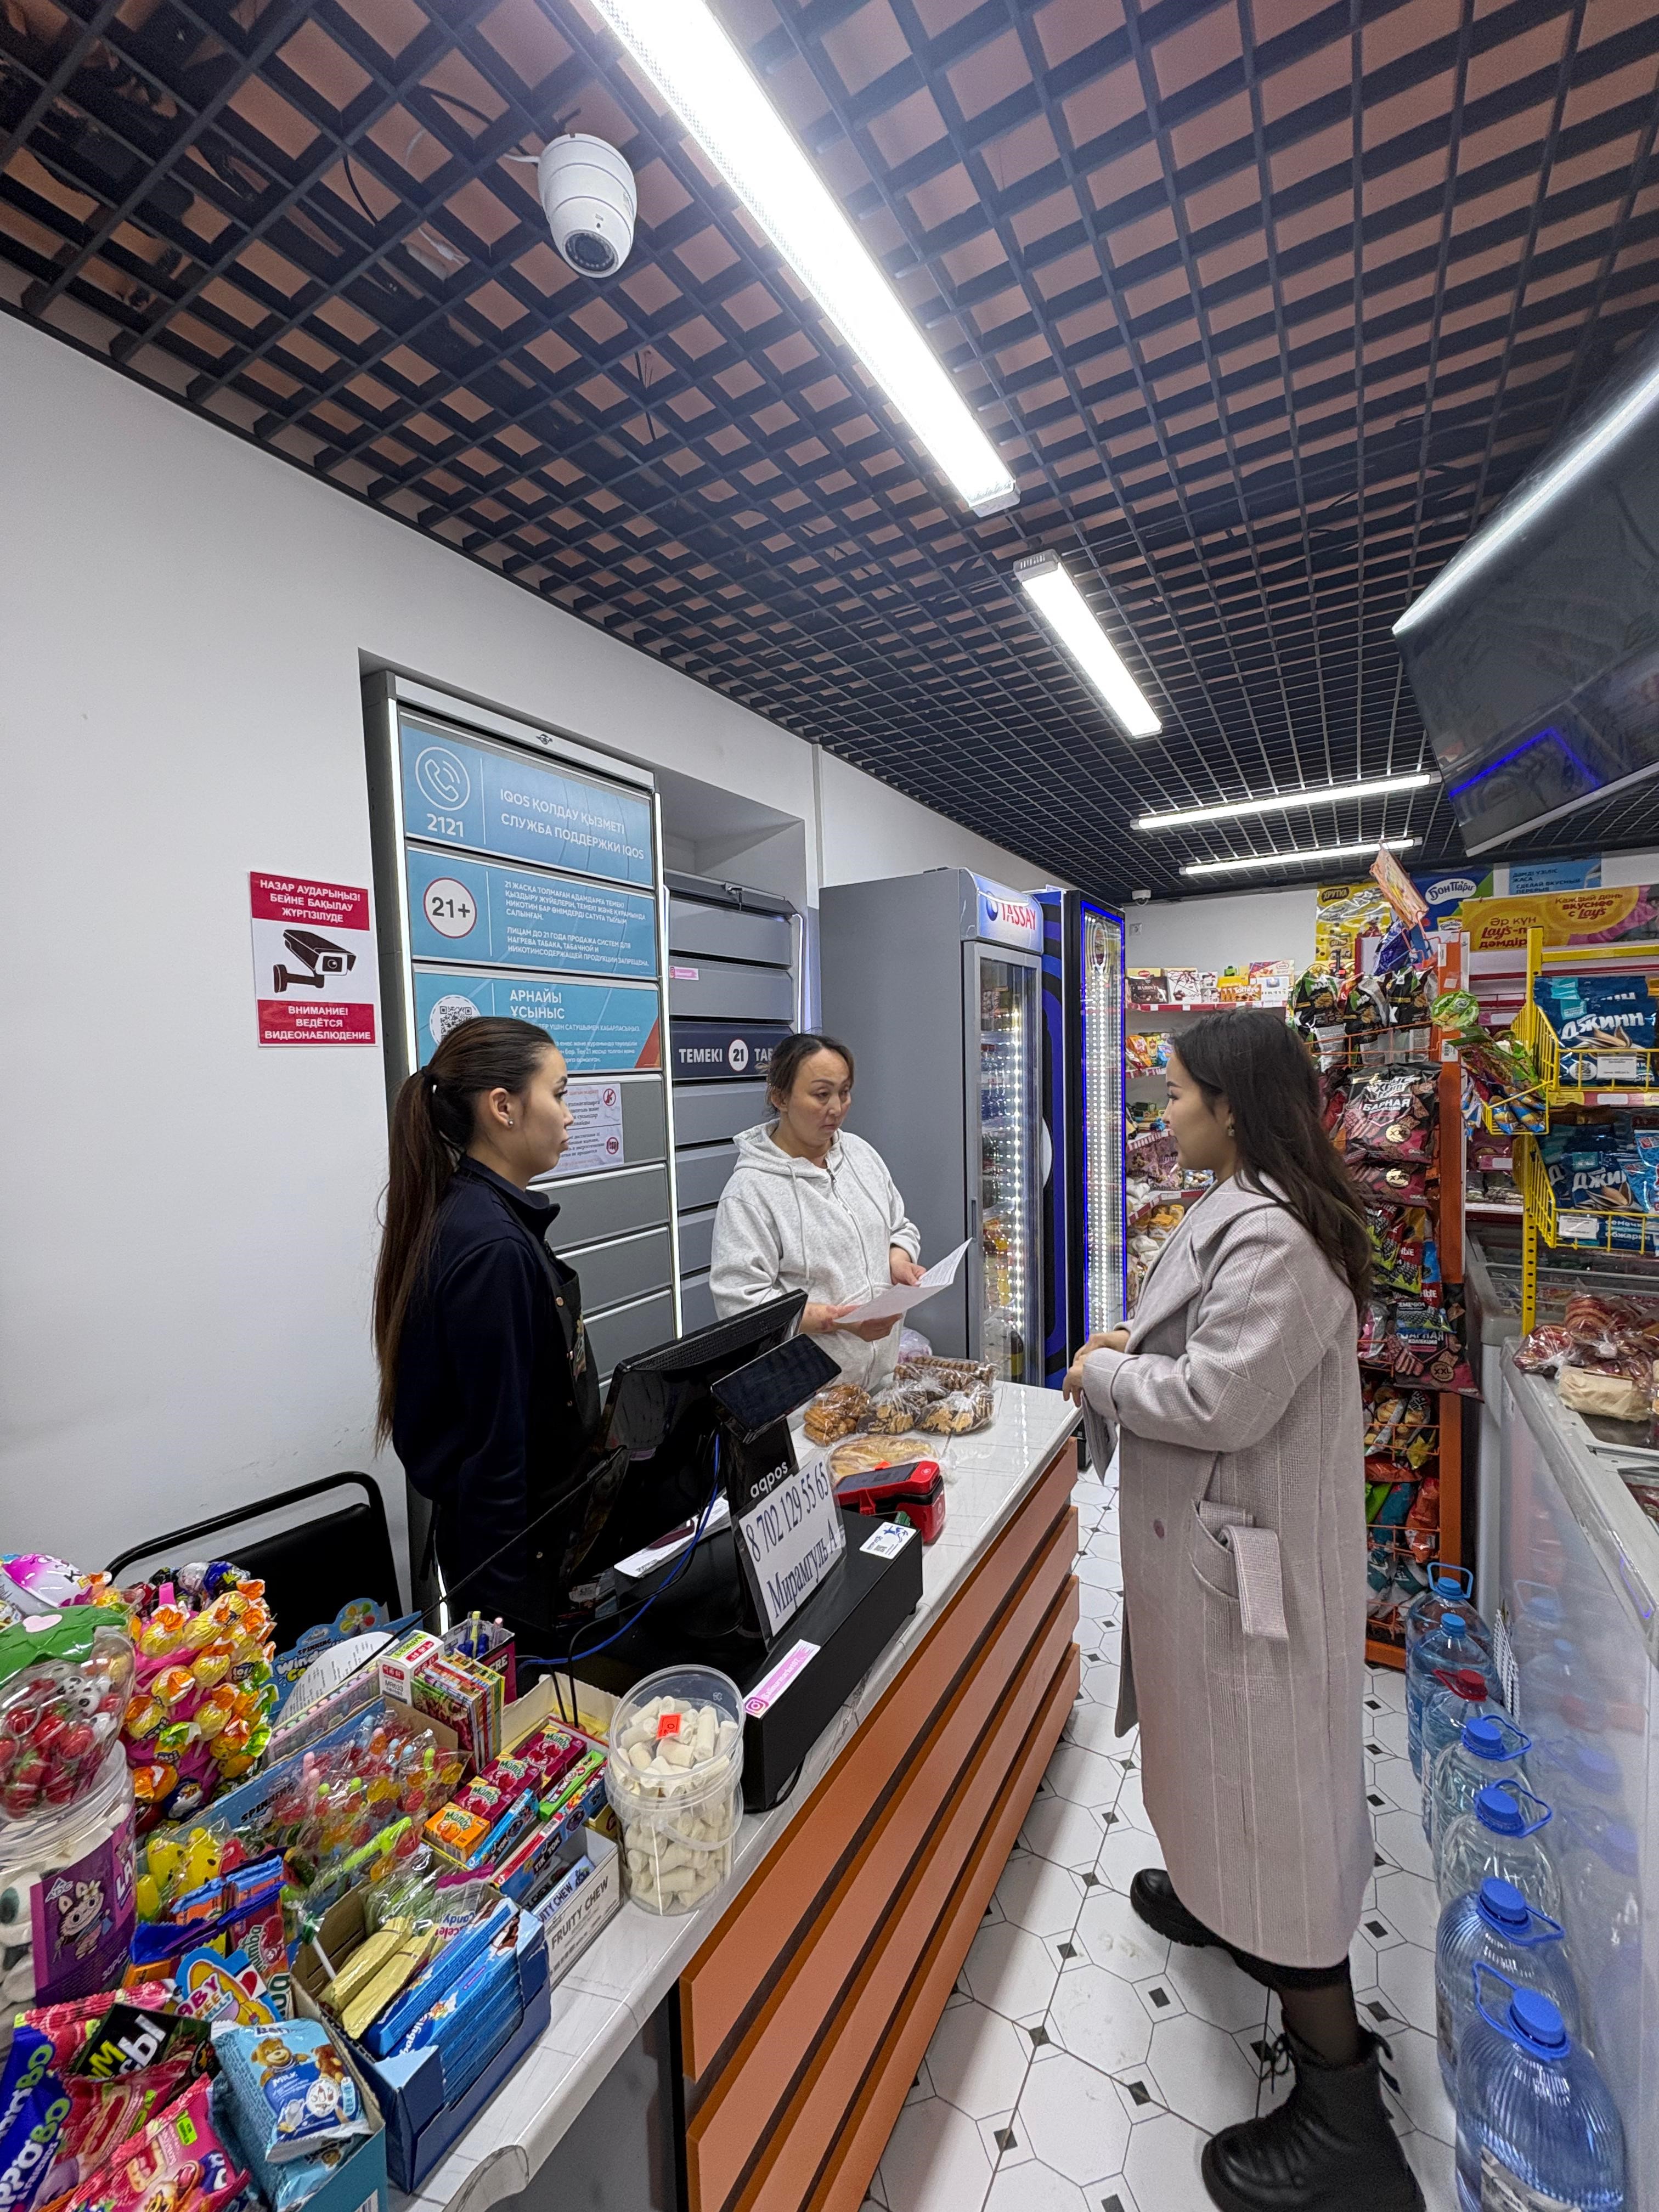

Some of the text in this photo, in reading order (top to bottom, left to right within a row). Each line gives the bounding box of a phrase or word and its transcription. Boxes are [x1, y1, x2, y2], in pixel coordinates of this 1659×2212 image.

[500, 788, 625, 834] IQOS ҚОЛДАУ ҚЫЗМЕТІ
[426, 813, 464, 838] 2121
[501, 812, 645, 860] СЛУЖБА ПОДДЕРЖКИ IQOS
[260, 879, 360, 903] НАЗАР АУДАРЫҢЫЗ!
[512, 882, 537, 893] ЖАСҚА
[537, 886, 571, 898] ТОЛМАҒАН
[1323, 888, 1348, 900] ХРУТКА
[270, 893, 353, 912] БЕЙНЕ БАҚЫЛАУ
[505, 890, 539, 902] ҚЫЗДЫРУ
[577, 902, 597, 912] ТЕМЕКІ
[597, 906, 613, 915] ЖӘНЕ
[505, 899, 539, 911] НИКОТИН
[1555, 893, 1623, 904] Каждый день
[1562, 900, 1614, 911] вкуснее
[282, 907, 344, 923] ЖҮРГІЗІЛУДЕ
[431, 896, 471, 918] 21+
[1577, 907, 1607, 920] Lay's
[1001, 902, 1036, 931] TASSAY
[1491, 916, 1537, 927] Әр күн
[507, 927, 532, 936] ЛИЦАМ
[532, 930, 543, 938] ДО
[550, 932, 567, 941] ГОДА
[567, 934, 597, 945] ПРОДАЖА
[597, 939, 619, 948] СИСТЕМ
[1481, 926, 1528, 940] Lay's-п
[507, 936, 537, 946] НАГРЕВА
[563, 943, 594, 952] ТАБАЧНОЙ
[1479, 938, 1527, 950] дәмдір
[507, 945, 583, 960] НИКОТИНСОДЕРЖАЩЕЙ
[509, 988, 562, 1005] АРНАЙЫ
[288, 1006, 348, 1015] ВНИМАНИЕ!
[510, 1006, 566, 1020] ҰСЫНЫС
[295, 1017, 343, 1029] ВЕДЁТСЯ
[264, 1030, 371, 1040] ВИДЕОНАБЛЮДЕНИЕ
[732, 1048, 745, 1062] 21
[1362, 1098, 1411, 1111] БАРНАЯ
[750, 1461, 789, 1498] aqpos
[746, 1461, 830, 1562] 8 702 129 55 65
[766, 1517, 838, 1619] Мирамгуль А
[275, 1648, 329, 1676] Wind
[533, 1835, 561, 1872] TIK TOK
[538, 1881, 573, 1922] UITY CHEW
[551, 1875, 609, 1949] FRUITY CHEW
[177, 1974, 218, 2016] ABY
